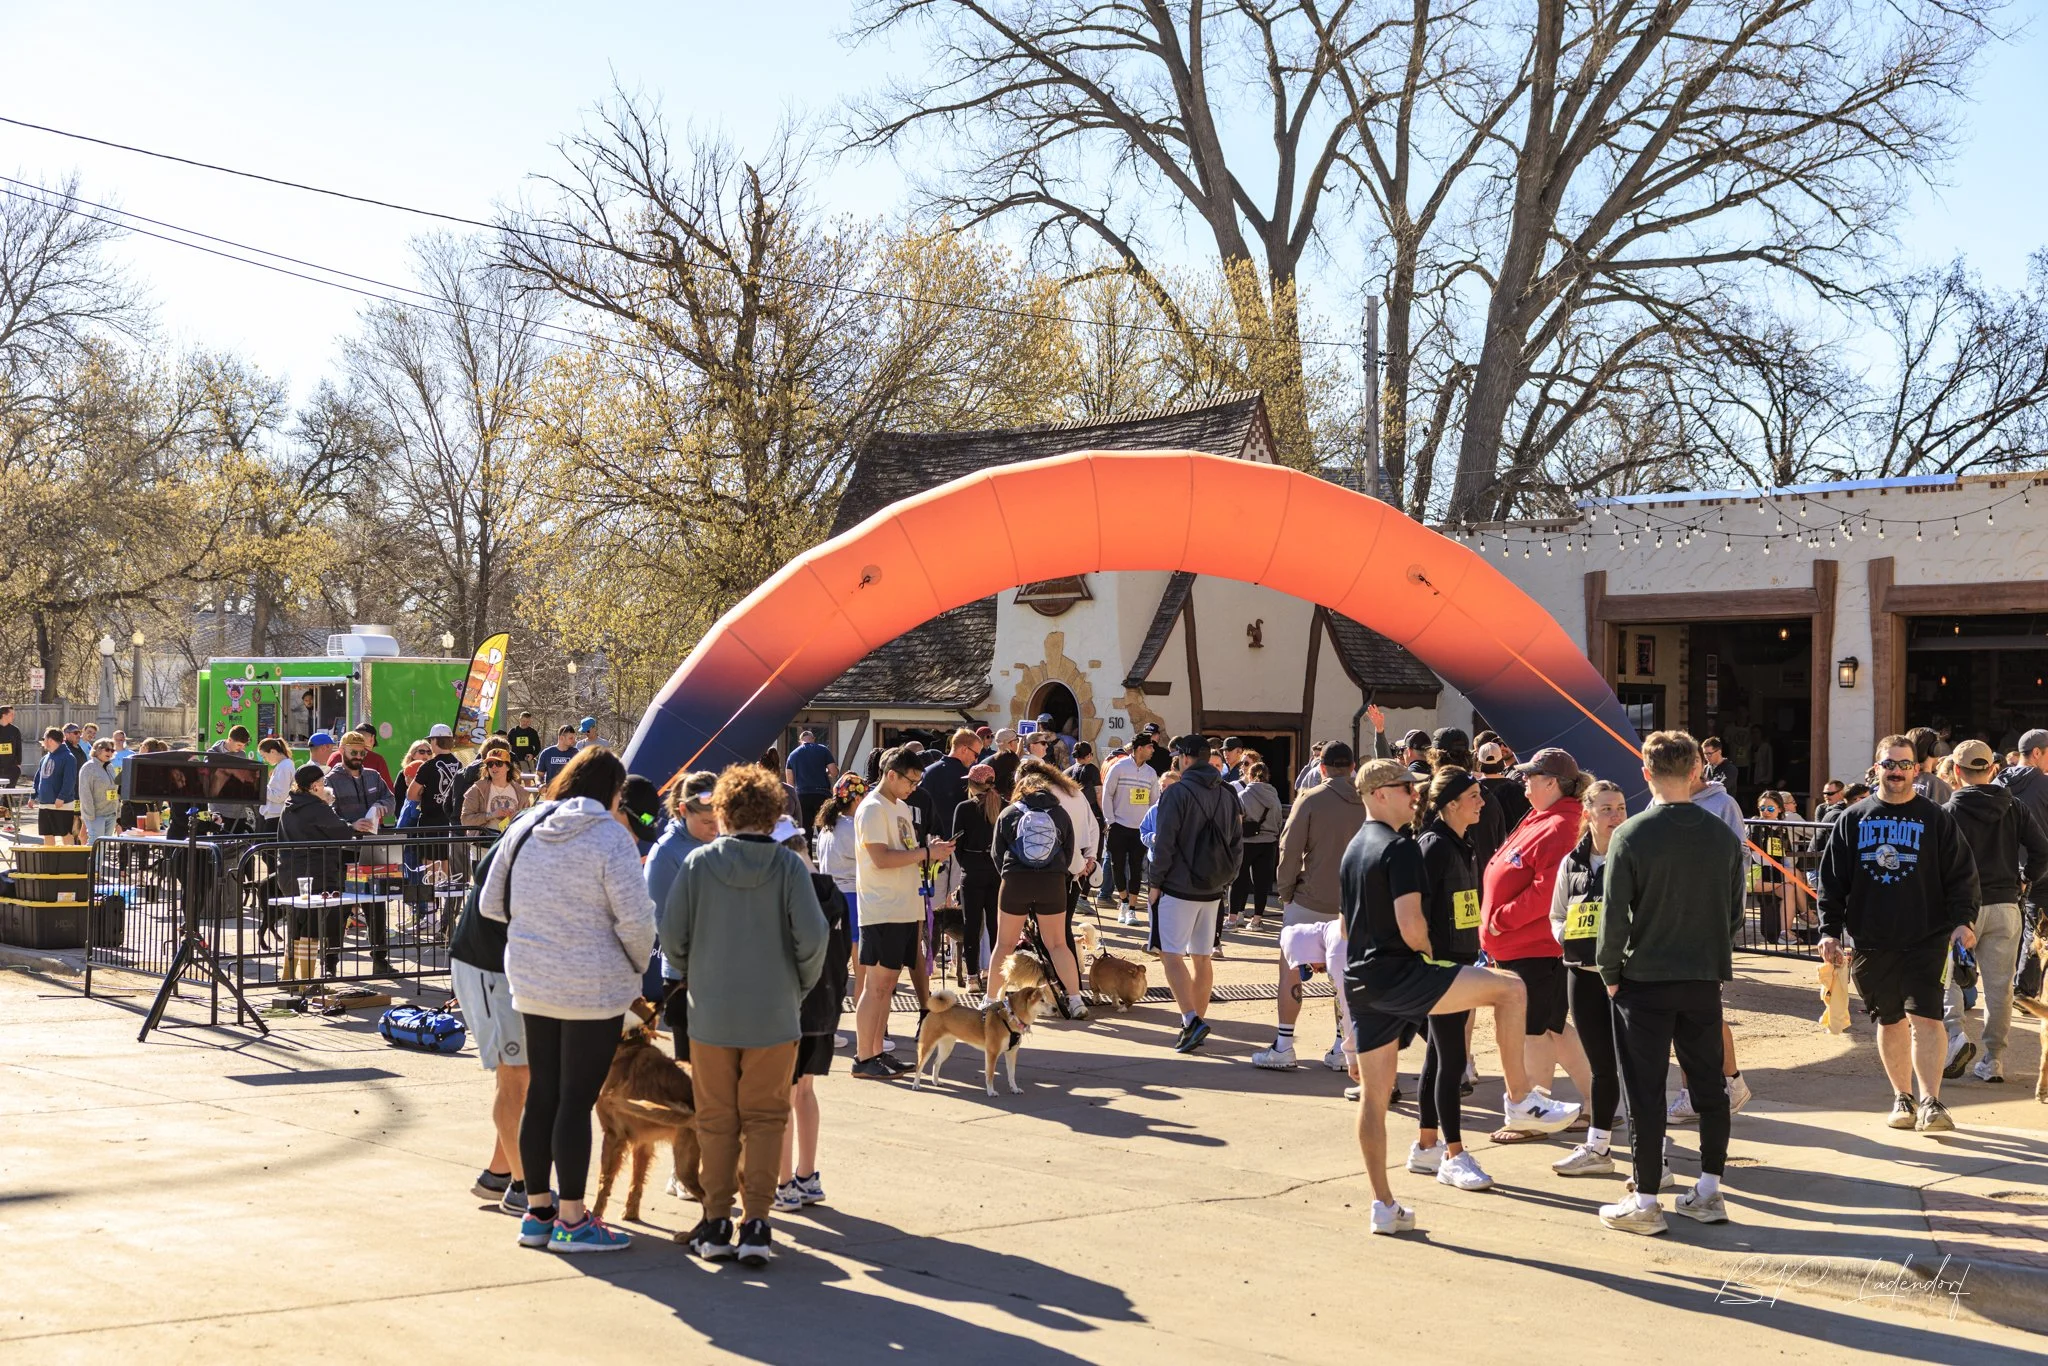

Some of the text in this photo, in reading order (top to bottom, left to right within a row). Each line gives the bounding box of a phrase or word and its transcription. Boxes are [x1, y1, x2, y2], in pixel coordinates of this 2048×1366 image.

[1108, 717, 1124, 729] 510
[1861, 815, 1924, 823] OOTBALL
[1858, 819, 1925, 851] DETROIT
[1588, 903, 1599, 912] 5K
[1577, 914, 1595, 928] 179
